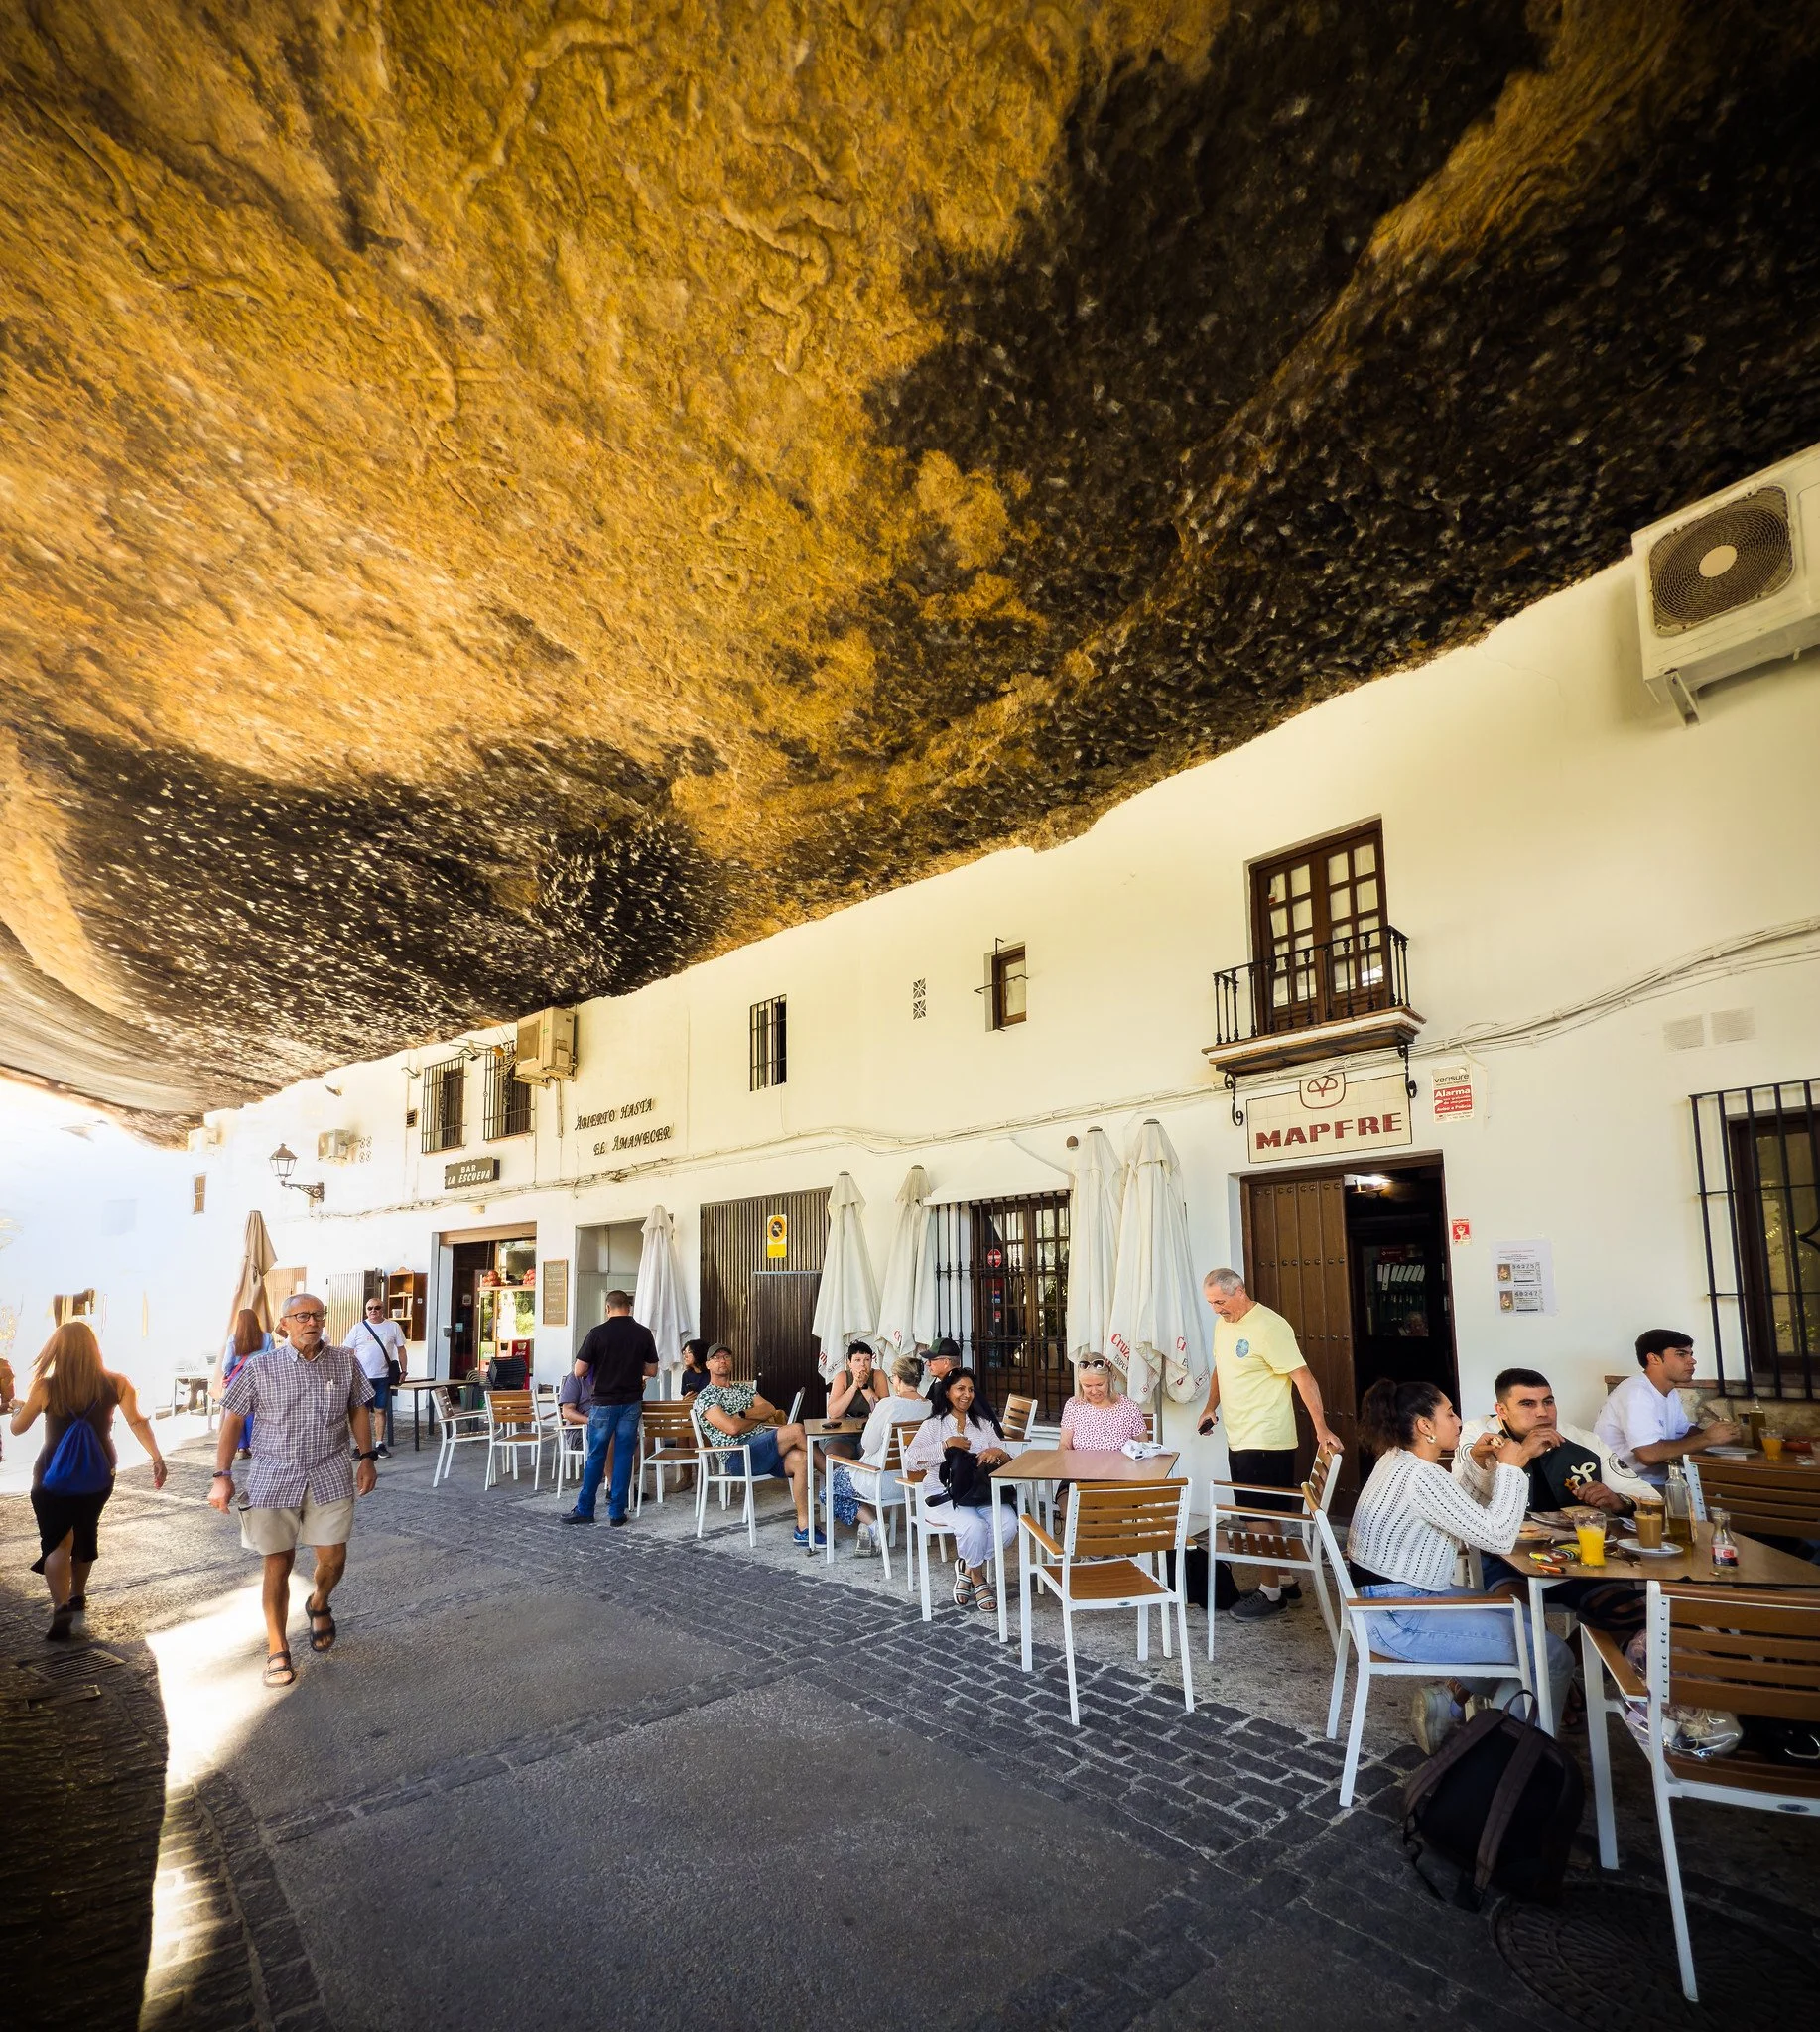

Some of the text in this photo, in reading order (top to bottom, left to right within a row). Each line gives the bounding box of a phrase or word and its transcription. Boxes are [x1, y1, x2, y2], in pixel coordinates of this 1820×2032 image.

[1434, 1074, 1470, 1082] verisure
[1435, 1088, 1471, 1097] Alarma
[575, 1098, 653, 1131] ABIERTO HASTA
[1255, 1112, 1402, 1150] MAPFRE
[593, 1125, 672, 1156] EL AMANECER
[460, 1164, 476, 1174] BAR
[447, 1170, 491, 1186] LA ESCUEVA
